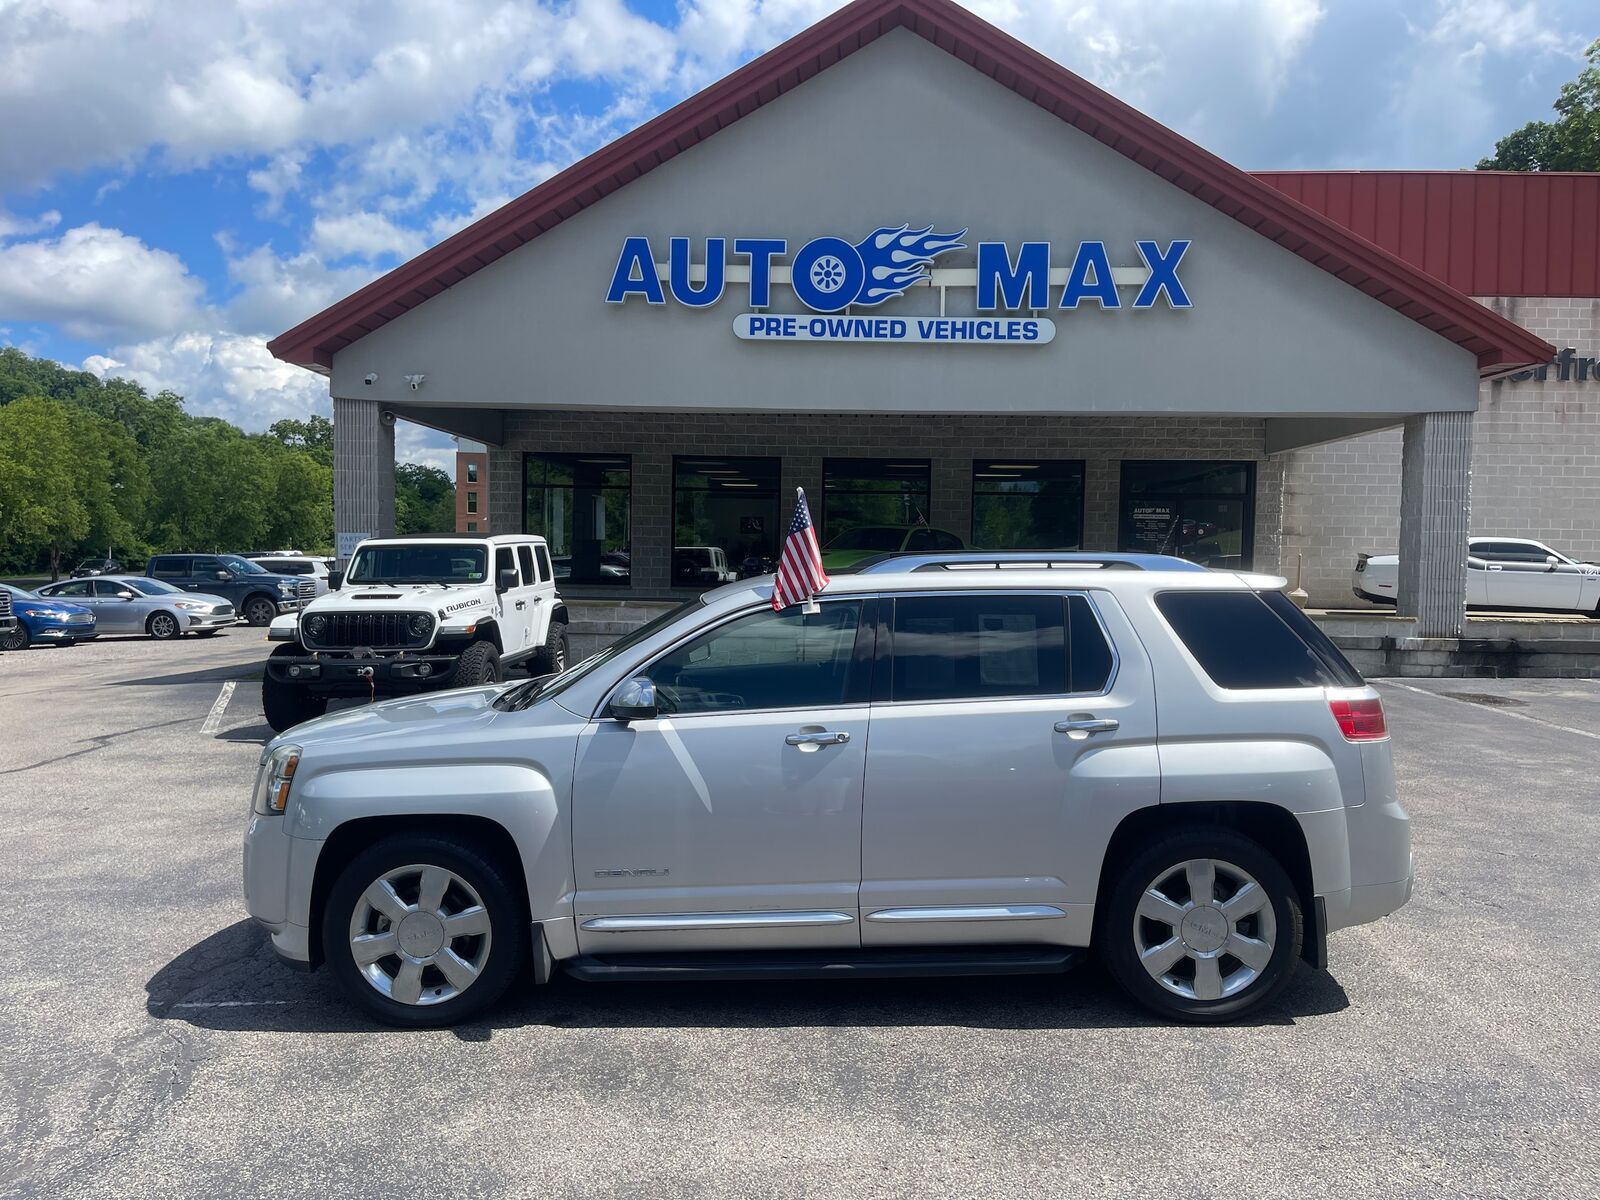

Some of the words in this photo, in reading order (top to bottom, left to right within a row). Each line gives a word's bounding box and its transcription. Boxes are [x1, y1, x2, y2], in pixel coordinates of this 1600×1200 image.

[605, 237, 866, 312] AUTO
[977, 240, 1193, 310] MAX
[750, 317, 907, 339] PRE-OWNED
[918, 319, 1039, 340] VEHICLES
[446, 599, 481, 612] RUBICON
